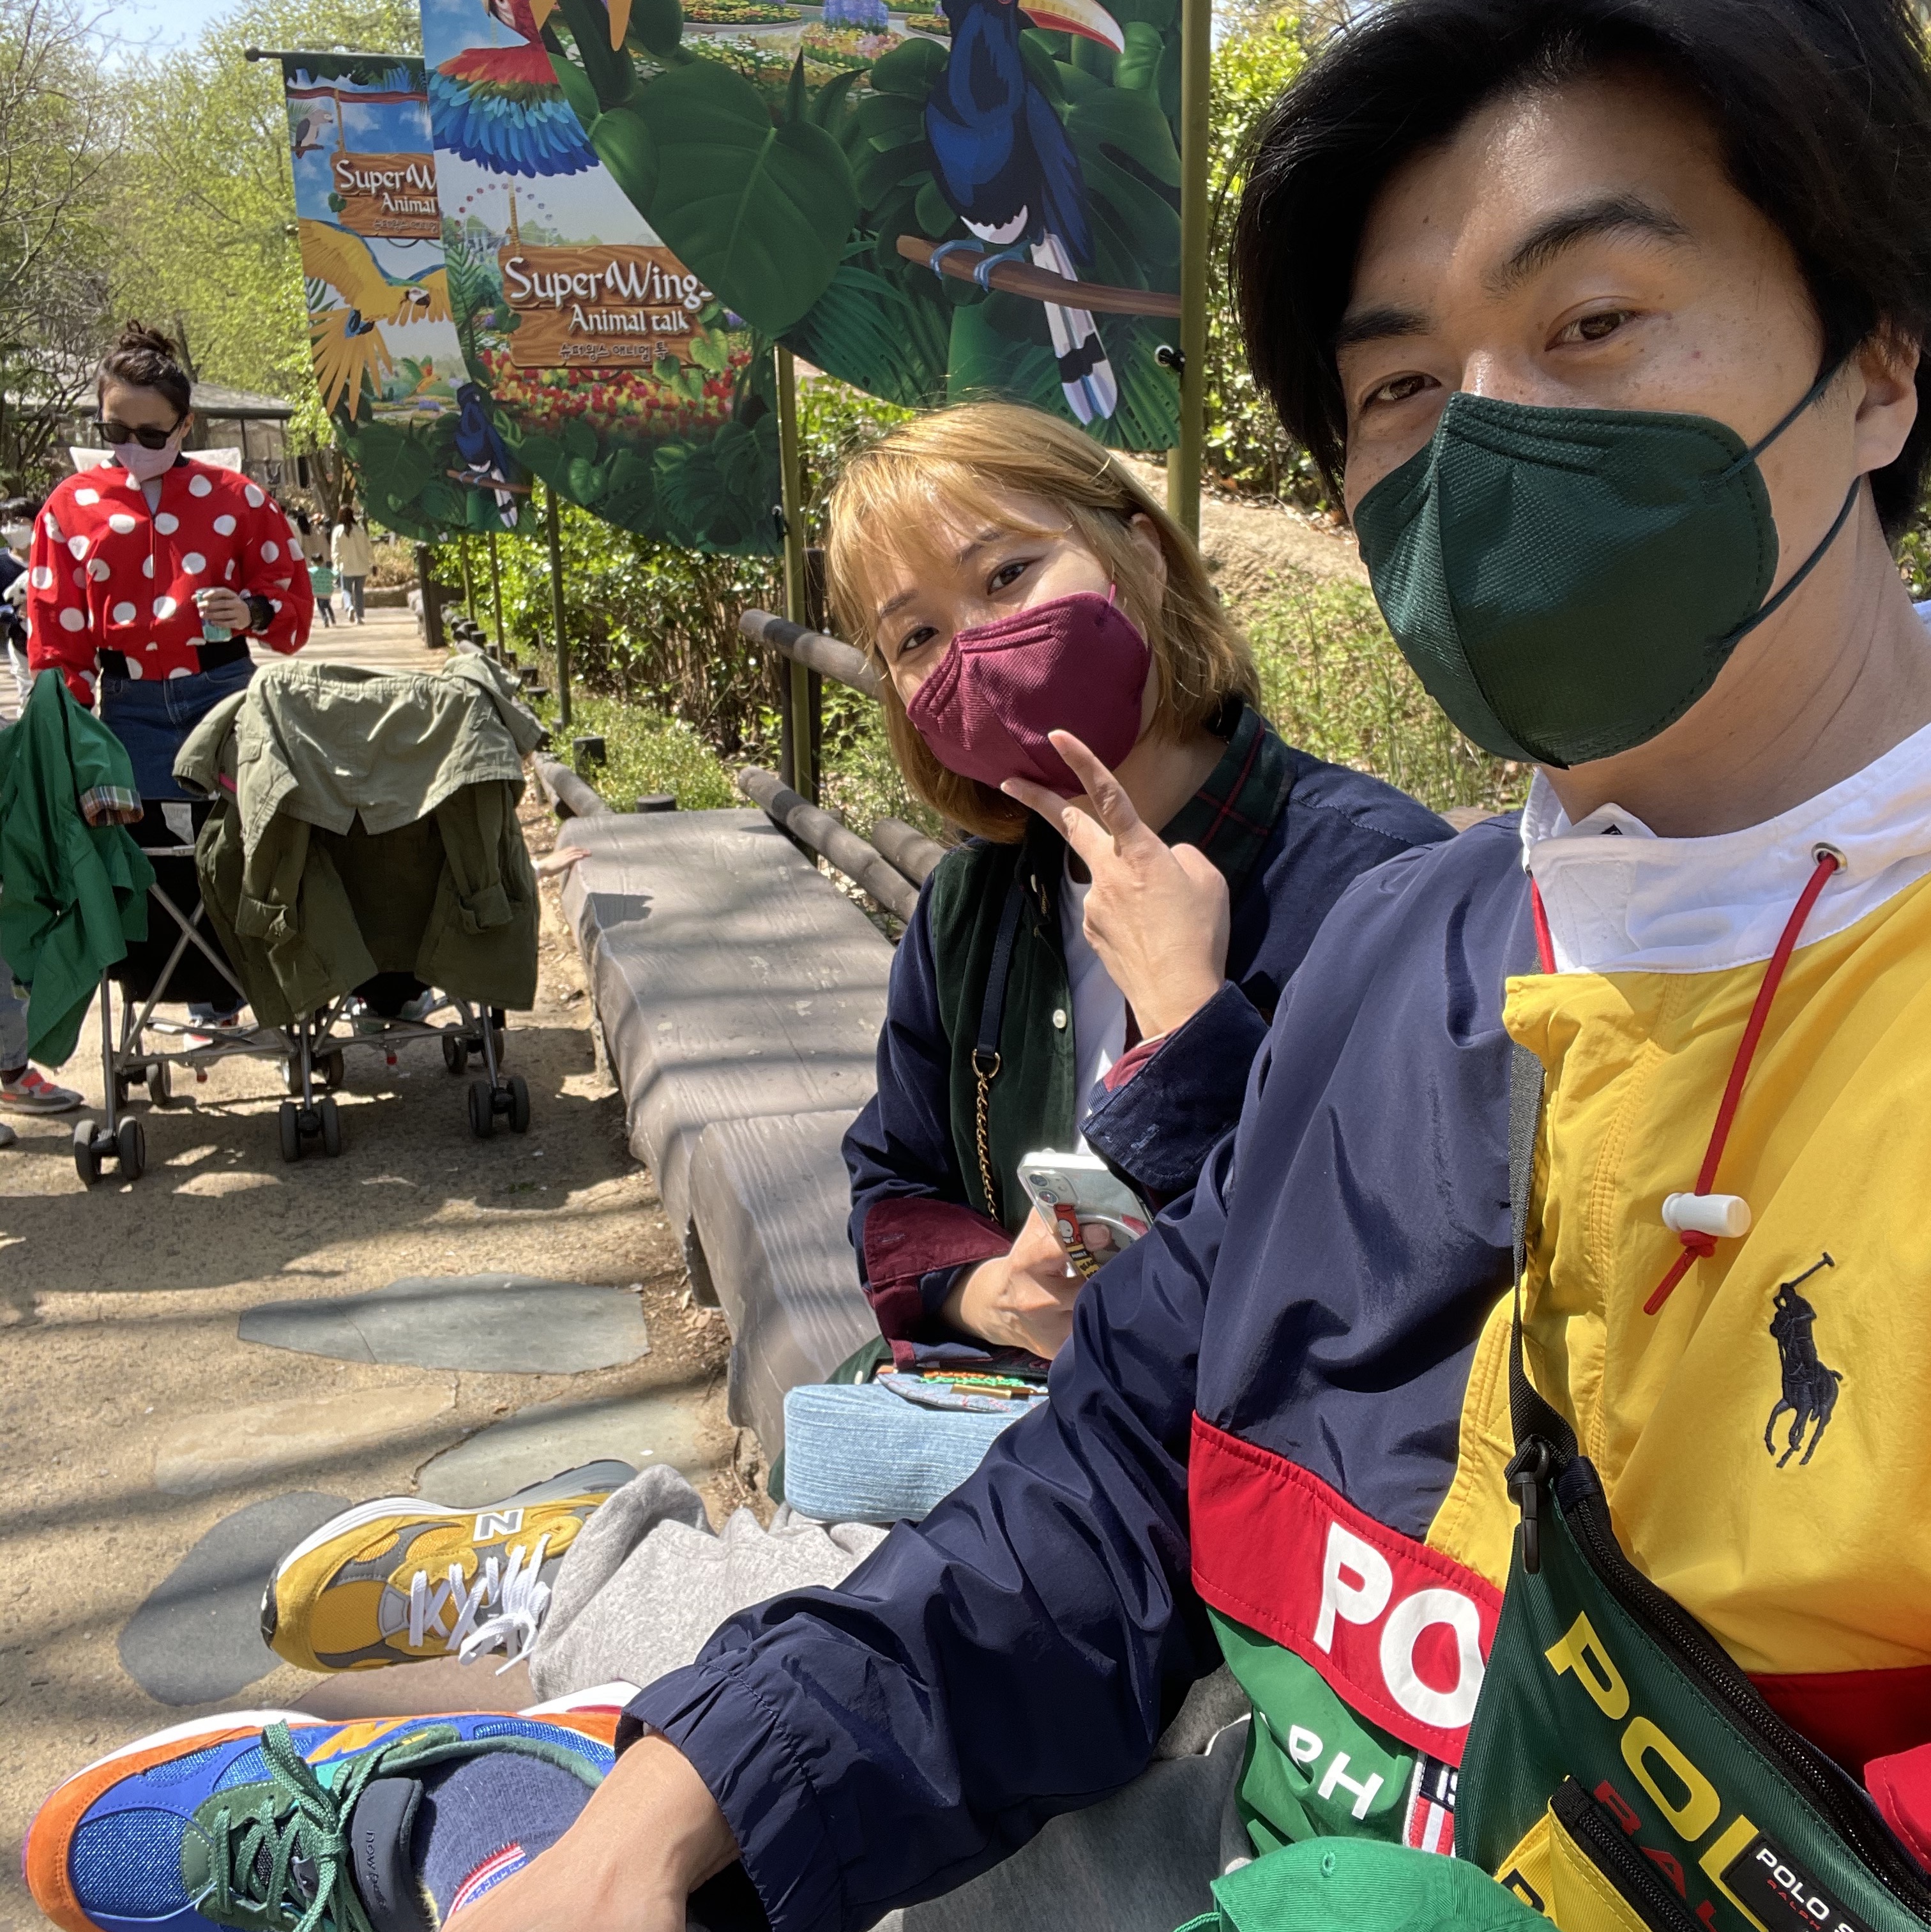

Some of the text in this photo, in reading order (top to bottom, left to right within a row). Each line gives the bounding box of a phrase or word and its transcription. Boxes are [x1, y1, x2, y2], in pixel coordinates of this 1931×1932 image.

[336, 159, 405, 195] Super
[381, 192, 435, 215] Animal
[504, 256, 604, 310] Super
[568, 303, 690, 334] Animal talk
[559, 341, 669, 361] 슈퍼윙스 애니멀 톡
[1314, 1520, 1485, 1730] PO
[1755, 1848, 1830, 1921] POLO
[1766, 1878, 1821, 1931] RALPH
